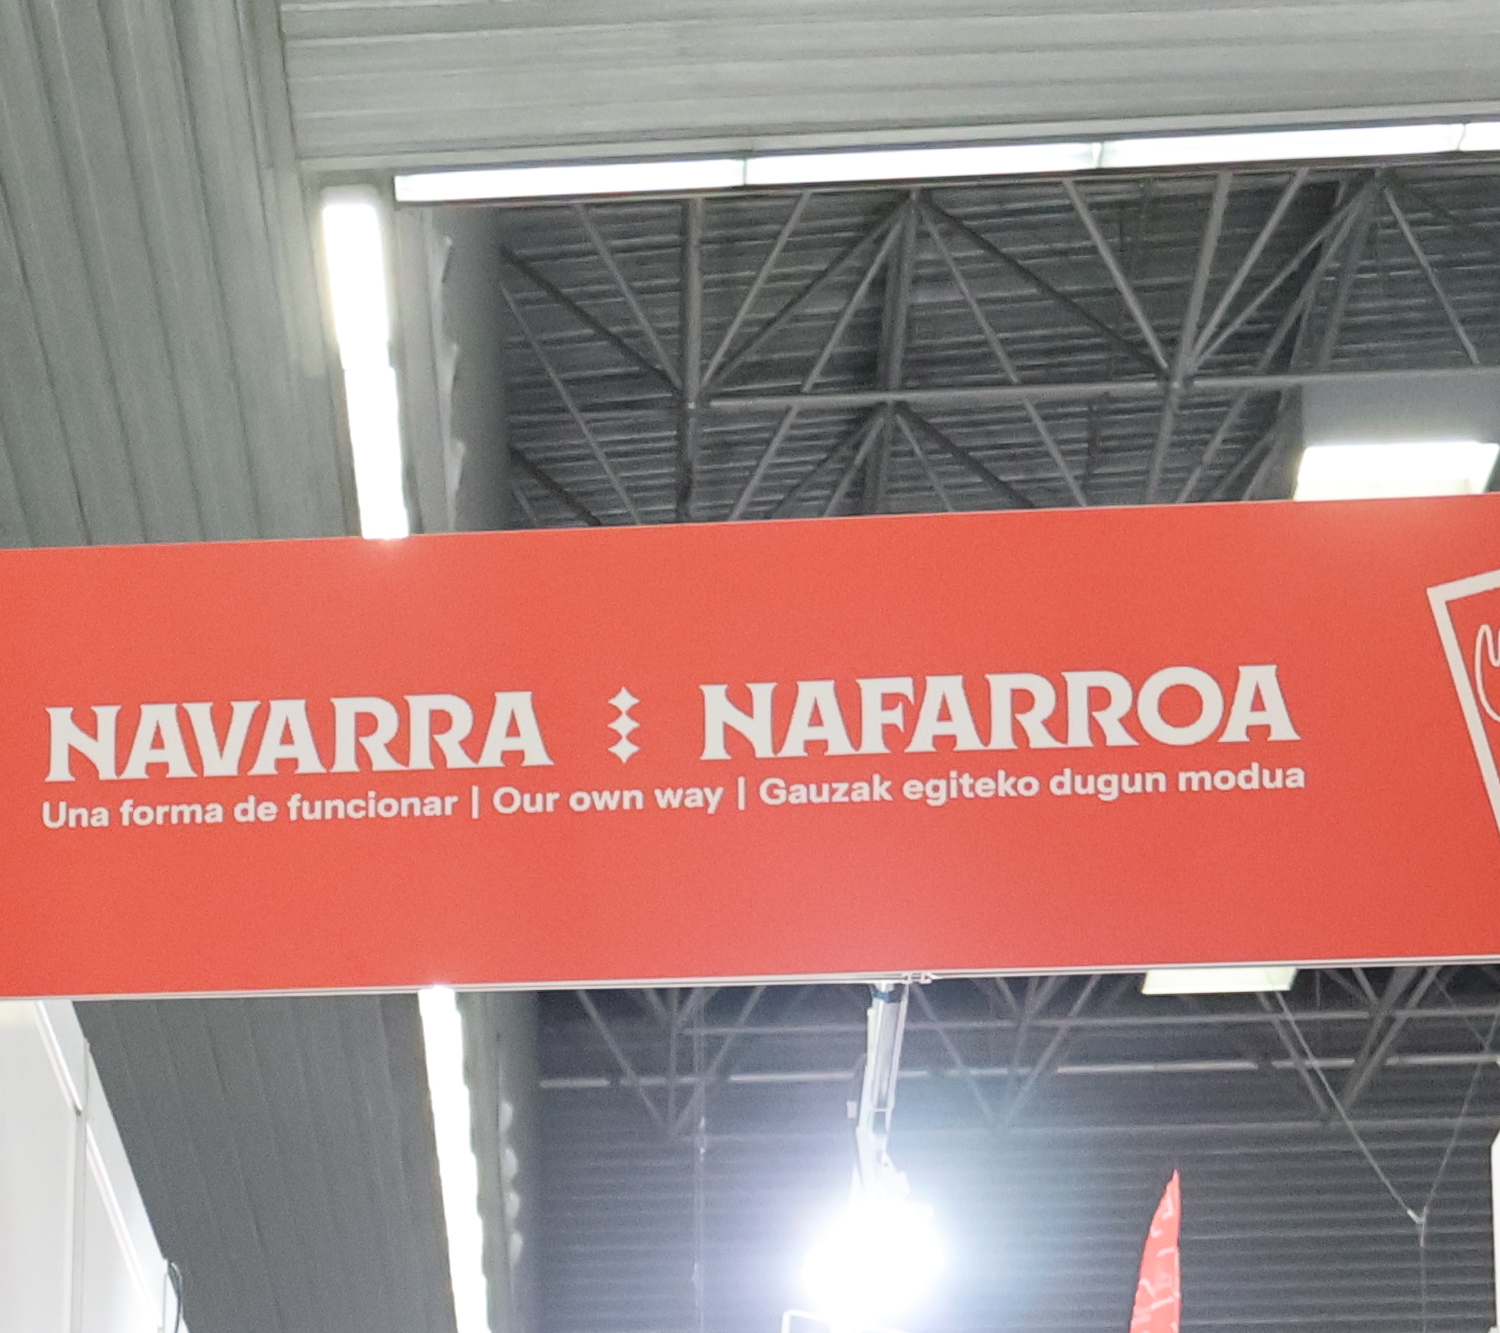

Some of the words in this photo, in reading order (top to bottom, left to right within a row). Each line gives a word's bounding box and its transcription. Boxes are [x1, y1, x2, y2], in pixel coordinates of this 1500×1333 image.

[44, 691, 554, 782] NAVARRA
[700, 664, 1300, 760] NAFARROA
[43, 801, 108, 828] Una
[119, 798, 223, 825] forma
[234, 795, 277, 822] de
[287, 792, 457, 820] funcionar
[493, 786, 560, 814] Our
[569, 788, 642, 811] own
[655, 787, 723, 814] way
[759, 775, 893, 806] Gauzak
[902, 770, 1040, 806] egiteko
[1049, 767, 1167, 801] dugun
[1177, 763, 1305, 792] modua
